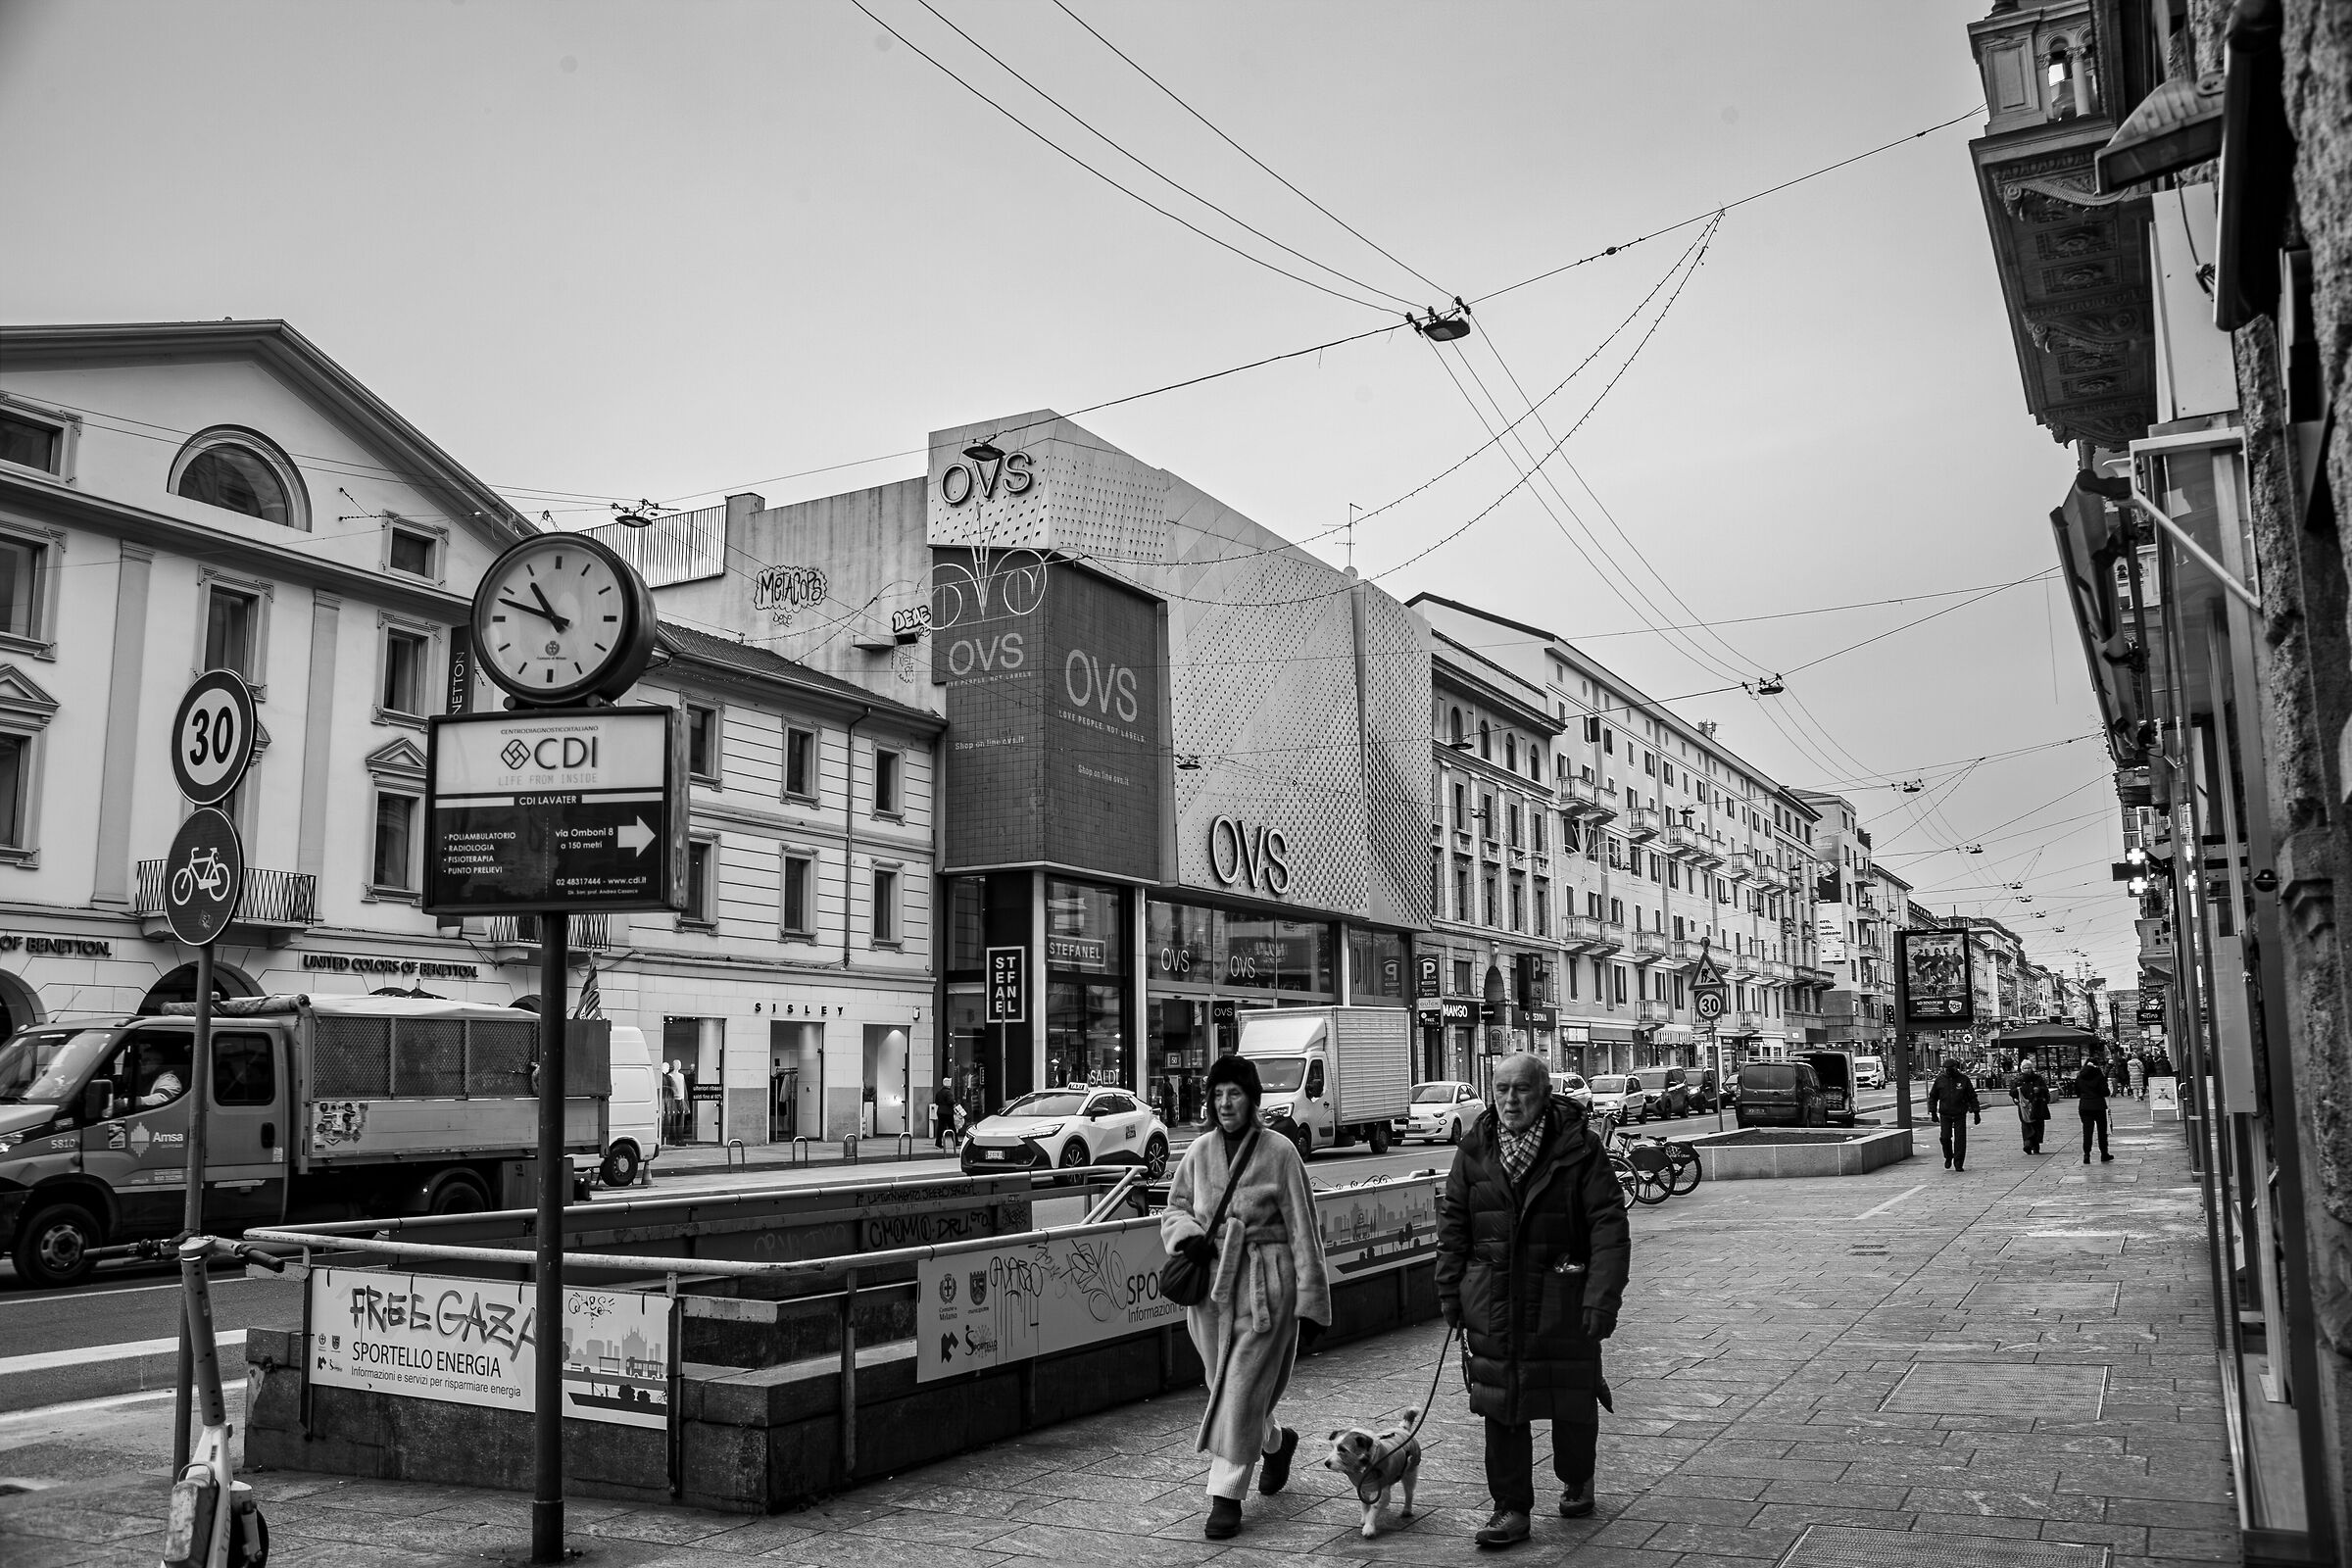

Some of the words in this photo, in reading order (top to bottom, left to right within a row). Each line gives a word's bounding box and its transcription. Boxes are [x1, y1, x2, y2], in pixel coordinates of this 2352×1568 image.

[940, 451, 1032, 505] OVS
[949, 632, 1024, 675] OVS
[452, 652, 465, 714] NETTON
[1065, 649, 1137, 722] OVS
[1058, 710, 1076, 721] LOVE
[1106, 725, 1118, 735] NOT
[189, 706, 233, 765] 30
[534, 736, 598, 770] CDI
[498, 775, 522, 786] LIFE
[529, 775, 554, 785] FROM
[562, 773, 597, 784] INSIDE
[1078, 764, 1093, 777] Shop
[519, 797, 536, 806] CDI
[538, 795, 577, 805] LAVATER
[448, 832, 516, 841] POLIAMBULATORIO
[570, 828, 607, 837] Omboni
[608, 827, 613, 836] 8
[1209, 814, 1290, 895] OVS
[0, 935, 24, 951] OF
[1049, 942, 1102, 959] STEFANEL
[303, 955, 350, 970] UNITED
[352, 958, 400, 972] COLORS
[401, 961, 418, 974] OF
[1161, 948, 1190, 972] OVS
[1230, 956, 1255, 978] OVS
[1533, 956, 1541, 979] P
[1423, 961, 1436, 980] P
[755, 1003, 844, 1016] SISLEY
[1214, 1007, 1233, 1017] OVS
[1443, 1004, 1468, 1018] MANGO
[1701, 999, 1719, 1012] 30
[51, 1139, 76, 1150] 5810
[152, 1131, 184, 1143] Amsa
[1127, 1270, 1163, 1305] SPO
[350, 1285, 432, 1333] FREE
[436, 1290, 537, 1362] GAZA
[352, 1341, 433, 1370] SPORTELLO
[437, 1350, 502, 1378] ENERGIA
[351, 1366, 396, 1381] Informazioni
[404, 1375, 428, 1385] servizi
[429, 1377, 444, 1390] per
[444, 1377, 488, 1393] risparmiare
[490, 1384, 521, 1397] energia
